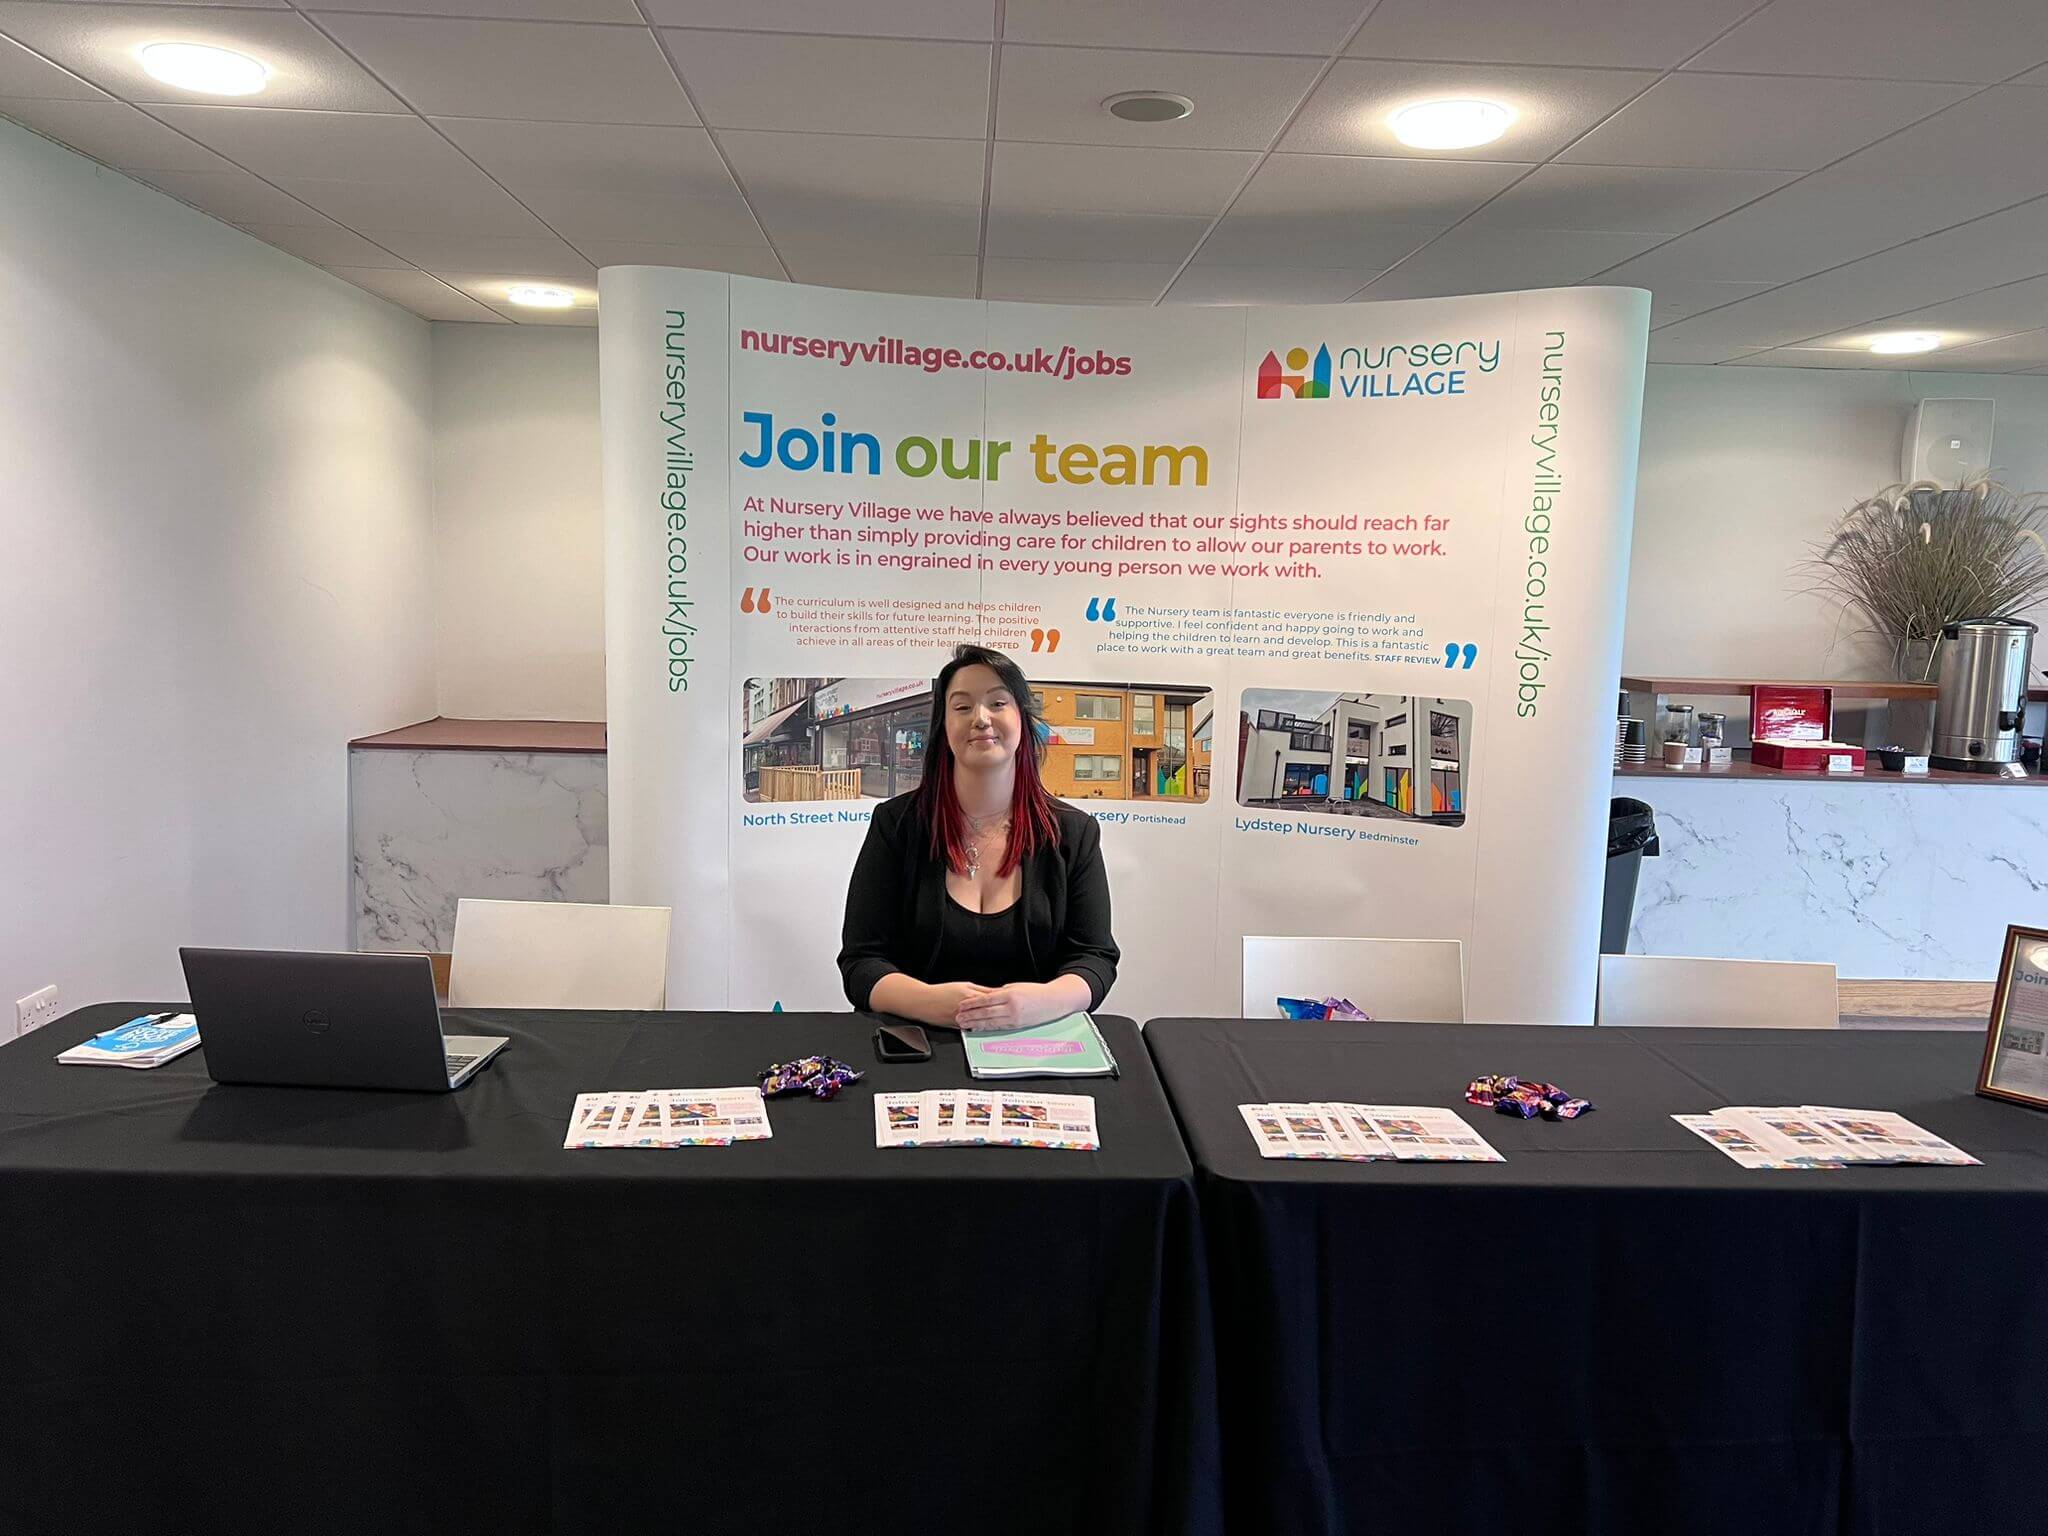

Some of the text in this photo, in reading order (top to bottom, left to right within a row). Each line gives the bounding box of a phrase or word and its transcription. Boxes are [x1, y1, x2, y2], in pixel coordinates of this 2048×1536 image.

[741, 328, 1132, 380] nurseryvillage.co.uk/jobs
[1340, 340, 1500, 372] nursery
[1339, 371, 1466, 398] VILLAGE
[738, 411, 1209, 486] Join our team
[660, 309, 697, 692] nurseryvillage.co.uk/jobs
[743, 496, 1450, 533] At Nursery Village we have always believed that our sights should reach far
[1515, 331, 1566, 718] nurseryvillage.co.uk/jobs
[744, 520, 1446, 557] higher than simply providing care for children to allow our parents to work.
[744, 546, 1322, 578] Our work is in engrained in every young person we work with.
[775, 596, 1041, 612] The curriculum is well designed and helps children
[1125, 606, 1415, 624] The Nursery team is fantastic everyone is friendly and
[777, 610, 1039, 626] to build their skills for future learning. The positive
[789, 623, 1026, 637] interactions from attentive staff help children
[1115, 619, 1174, 629] supportive.
[1184, 620, 1203, 629] feel
[1206, 621, 1259, 630] confident
[1261, 623, 1282, 631] and
[1285, 623, 1320, 634] happy
[1323, 625, 1354, 636] going
[1358, 626, 1369, 635] to
[1372, 627, 1399, 636] work
[1402, 628, 1424, 637] and
[796, 637, 836, 645] achieve
[839, 637, 849, 646] in
[851, 637, 863, 647] all
[897, 638, 908, 646] of
[909, 638, 934, 647] their
[985, 642, 1019, 650] OFSTED
[1109, 631, 1149, 642] helping
[1153, 632, 1170, 641] the
[1172, 633, 1216, 642] children
[1220, 635, 1231, 643] to
[1233, 635, 1260, 643] learn
[1263, 636, 1284, 644] and
[1287, 636, 1334, 648] develop.
[1336, 638, 1359, 647] This
[1361, 639, 1370, 648] is
[1381, 638, 1429, 651] fantastic
[1096, 643, 1125, 654] place
[1128, 644, 1138, 652] to
[1141, 645, 1167, 653] work
[1169, 645, 1194, 655] with
[1206, 647, 1234, 657] great
[1238, 648, 1265, 656] team
[1268, 648, 1289, 657] and
[1292, 650, 1321, 660] great
[1324, 650, 1372, 662] benefits.
[1375, 654, 1402, 663] STAFF
[1404, 656, 1440, 665] REVIEW
[743, 811, 870, 826] North Street Nurs
[1090, 812, 1185, 824] rsery Portishead
[1235, 818, 1419, 846] Lydstep Nursery Bedminster
